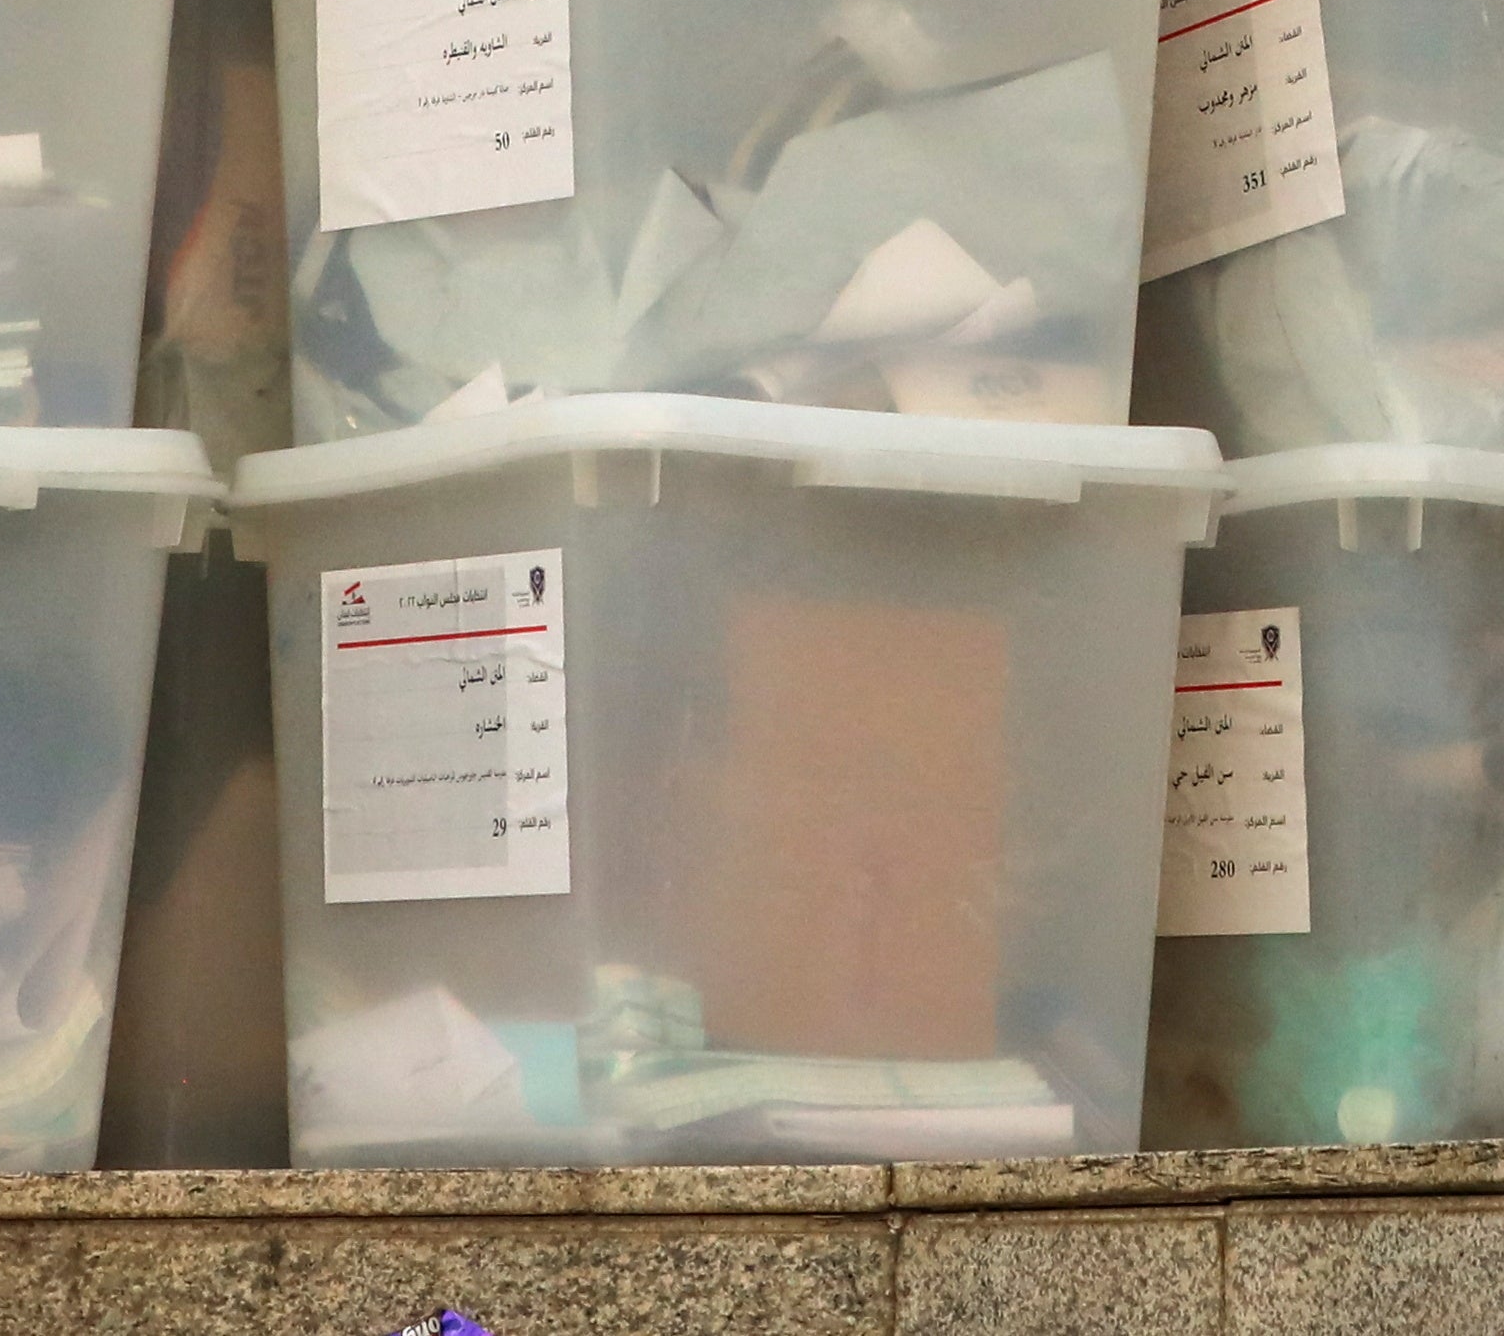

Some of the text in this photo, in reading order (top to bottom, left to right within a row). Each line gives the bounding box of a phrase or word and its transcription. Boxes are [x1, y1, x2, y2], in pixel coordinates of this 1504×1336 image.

[493, 131, 511, 152] 50
[1243, 169, 1268, 193] 351
[492, 817, 508, 838] 29
[1211, 860, 1236, 879] 280
